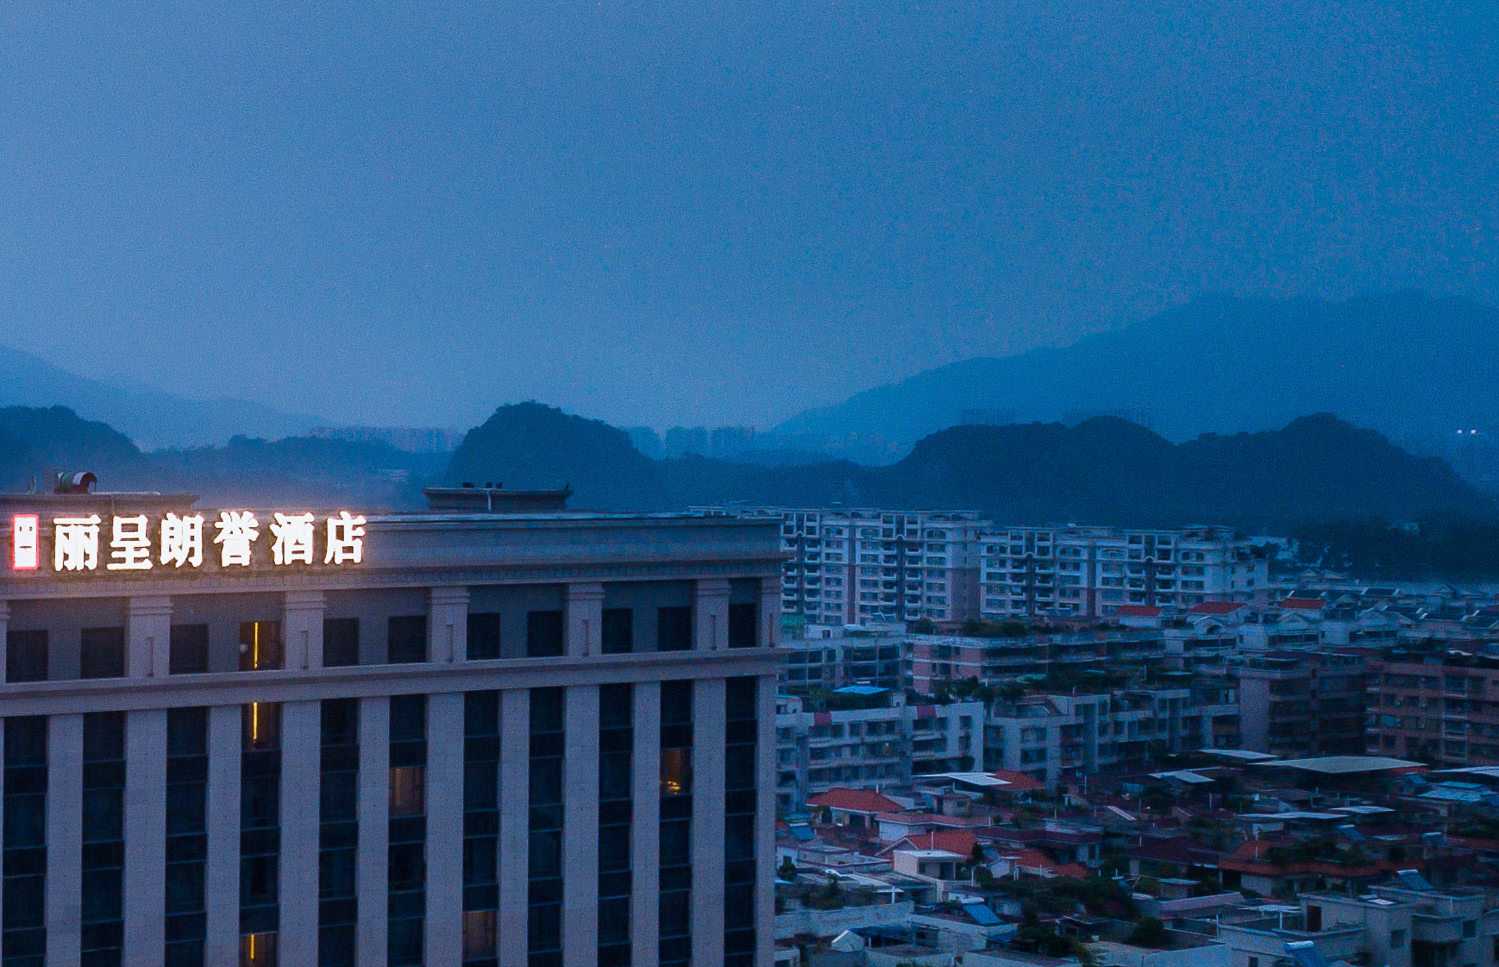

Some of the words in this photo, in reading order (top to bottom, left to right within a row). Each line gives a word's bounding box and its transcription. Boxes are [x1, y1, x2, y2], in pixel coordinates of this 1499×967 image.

[52, 510, 368, 572] 丽呈朗誉酒店
